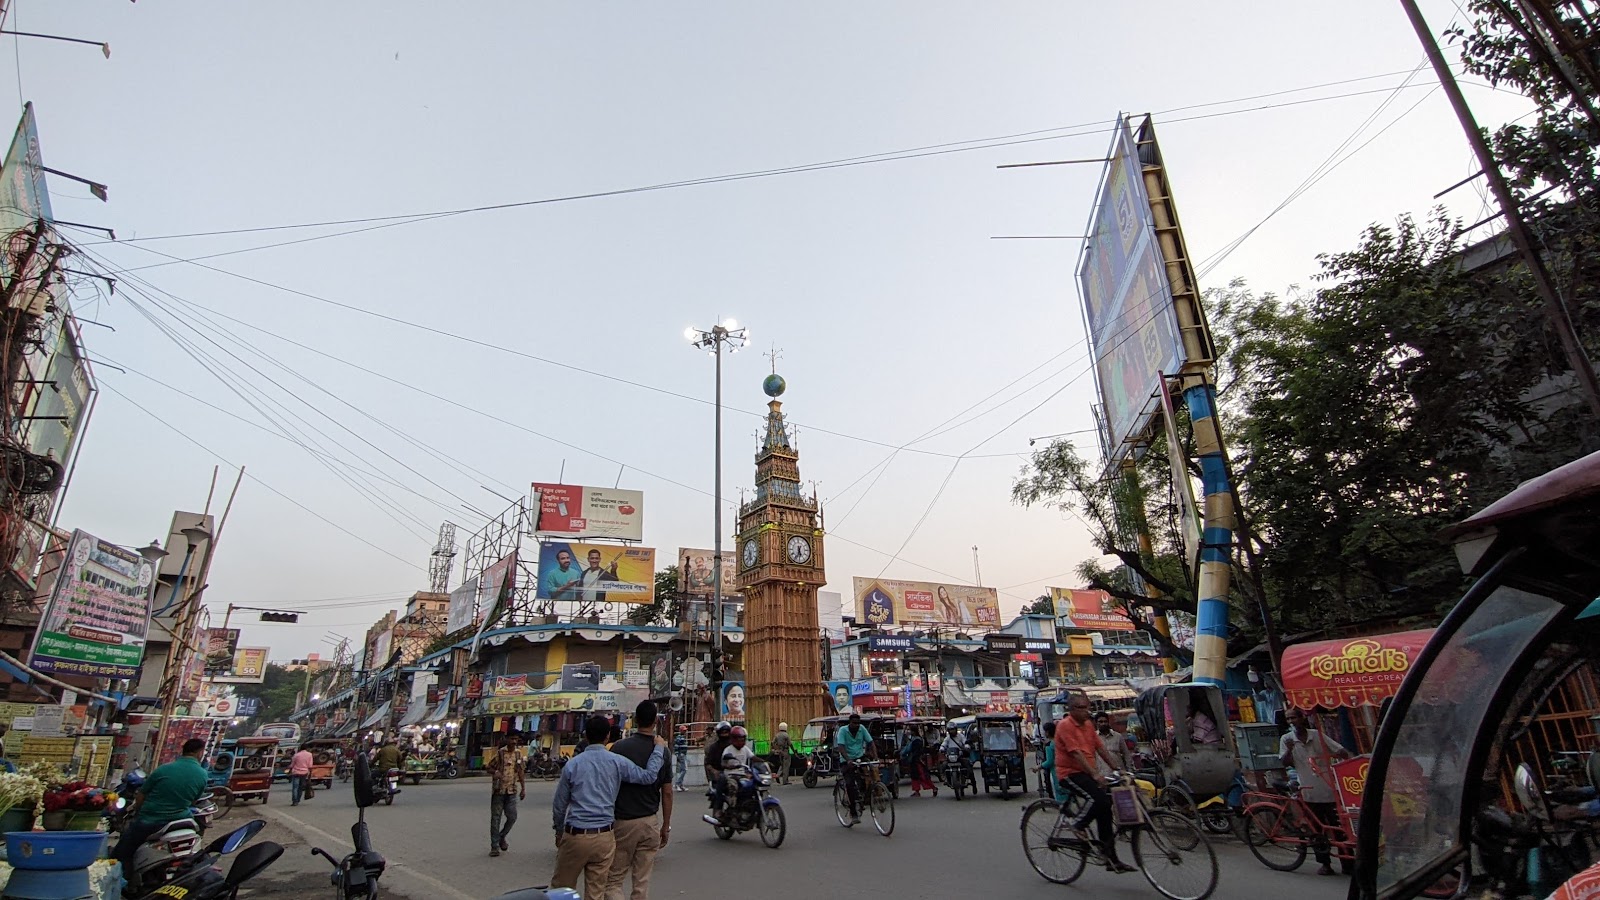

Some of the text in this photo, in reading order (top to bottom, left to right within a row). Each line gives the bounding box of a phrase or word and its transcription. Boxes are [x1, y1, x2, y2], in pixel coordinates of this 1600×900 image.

[876, 638, 911, 647] SAMSUNG
[991, 641, 1017, 649] SAMSUNG
[1025, 641, 1051, 649] SAMSUNG
[1310, 649, 1409, 680] Kamal's
[1335, 675, 1356, 685] REAL
[1359, 674, 1374, 683] ICE
[855, 682, 870, 691] vivo
